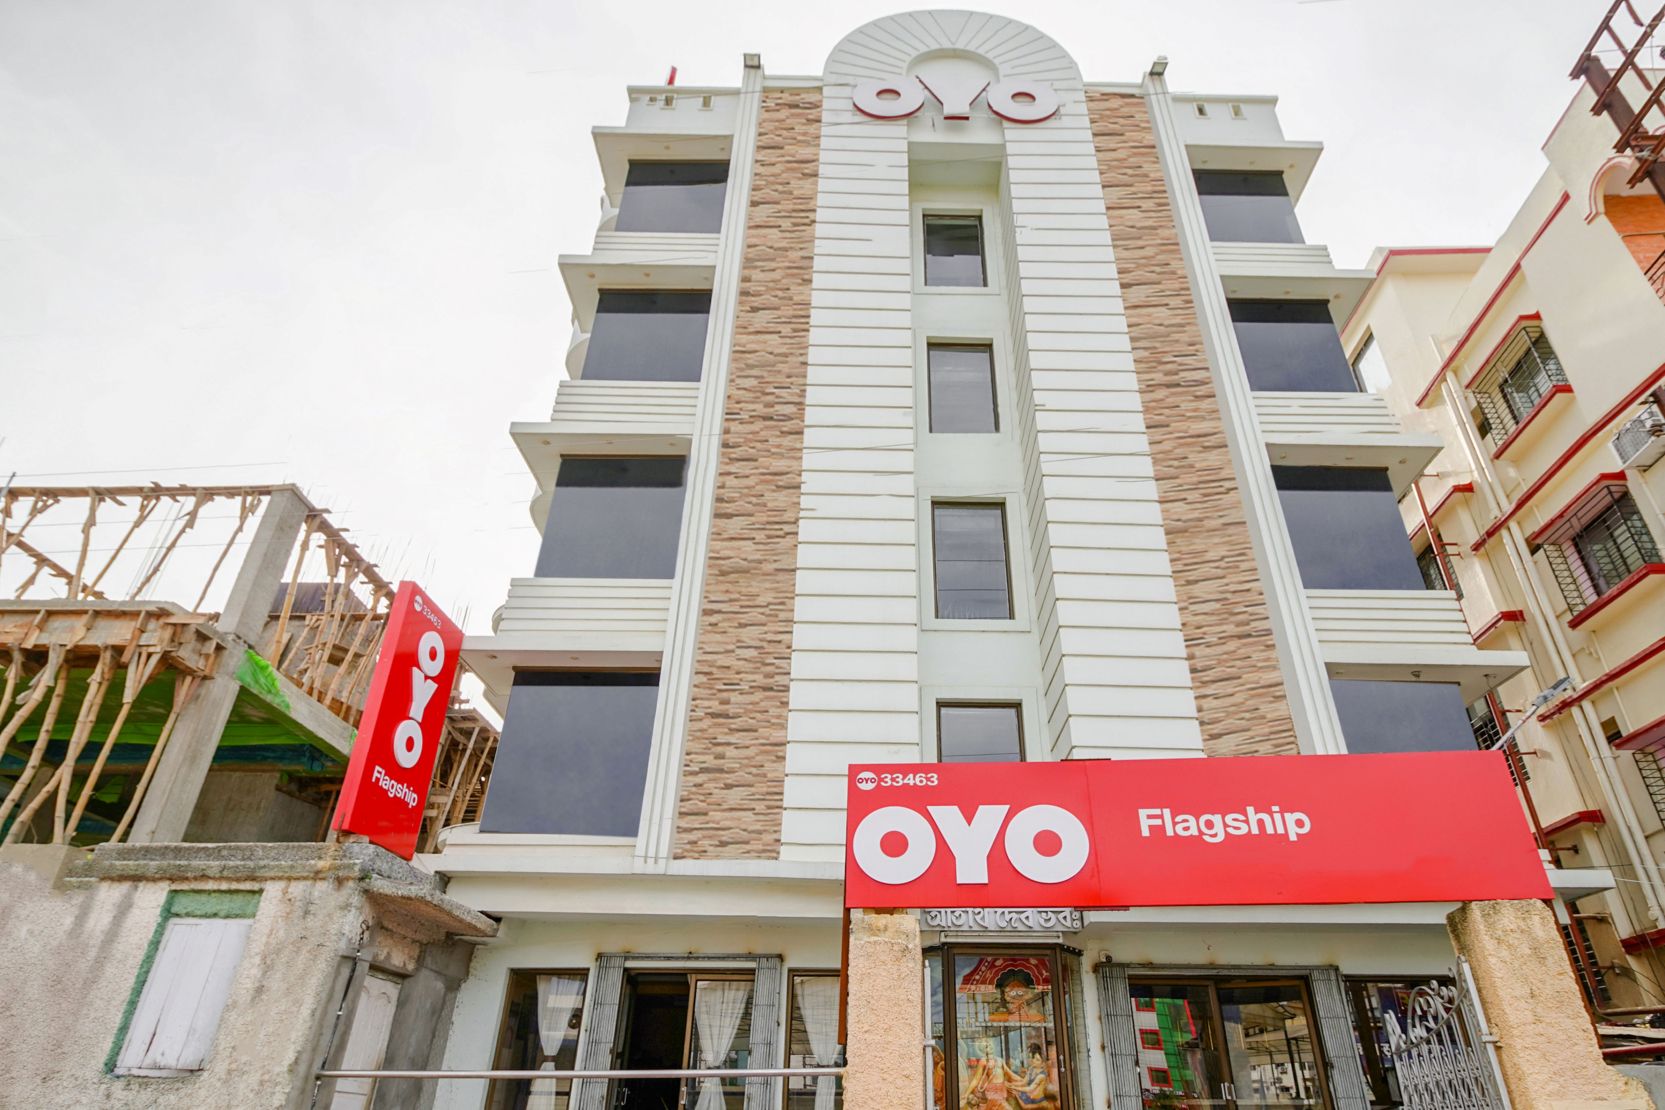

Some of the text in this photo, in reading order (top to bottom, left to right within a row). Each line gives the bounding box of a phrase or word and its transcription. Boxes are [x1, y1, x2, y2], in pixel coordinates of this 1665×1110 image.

[852, 74, 1060, 124] OYO
[393, 631, 445, 768] OYO
[371, 764, 418, 808] Flagship
[880, 773, 939, 787] 33463
[852, 804, 1091, 885] OYO
[1138, 805, 1312, 843] Flagship
[995, 908, 1034, 929] দেব
